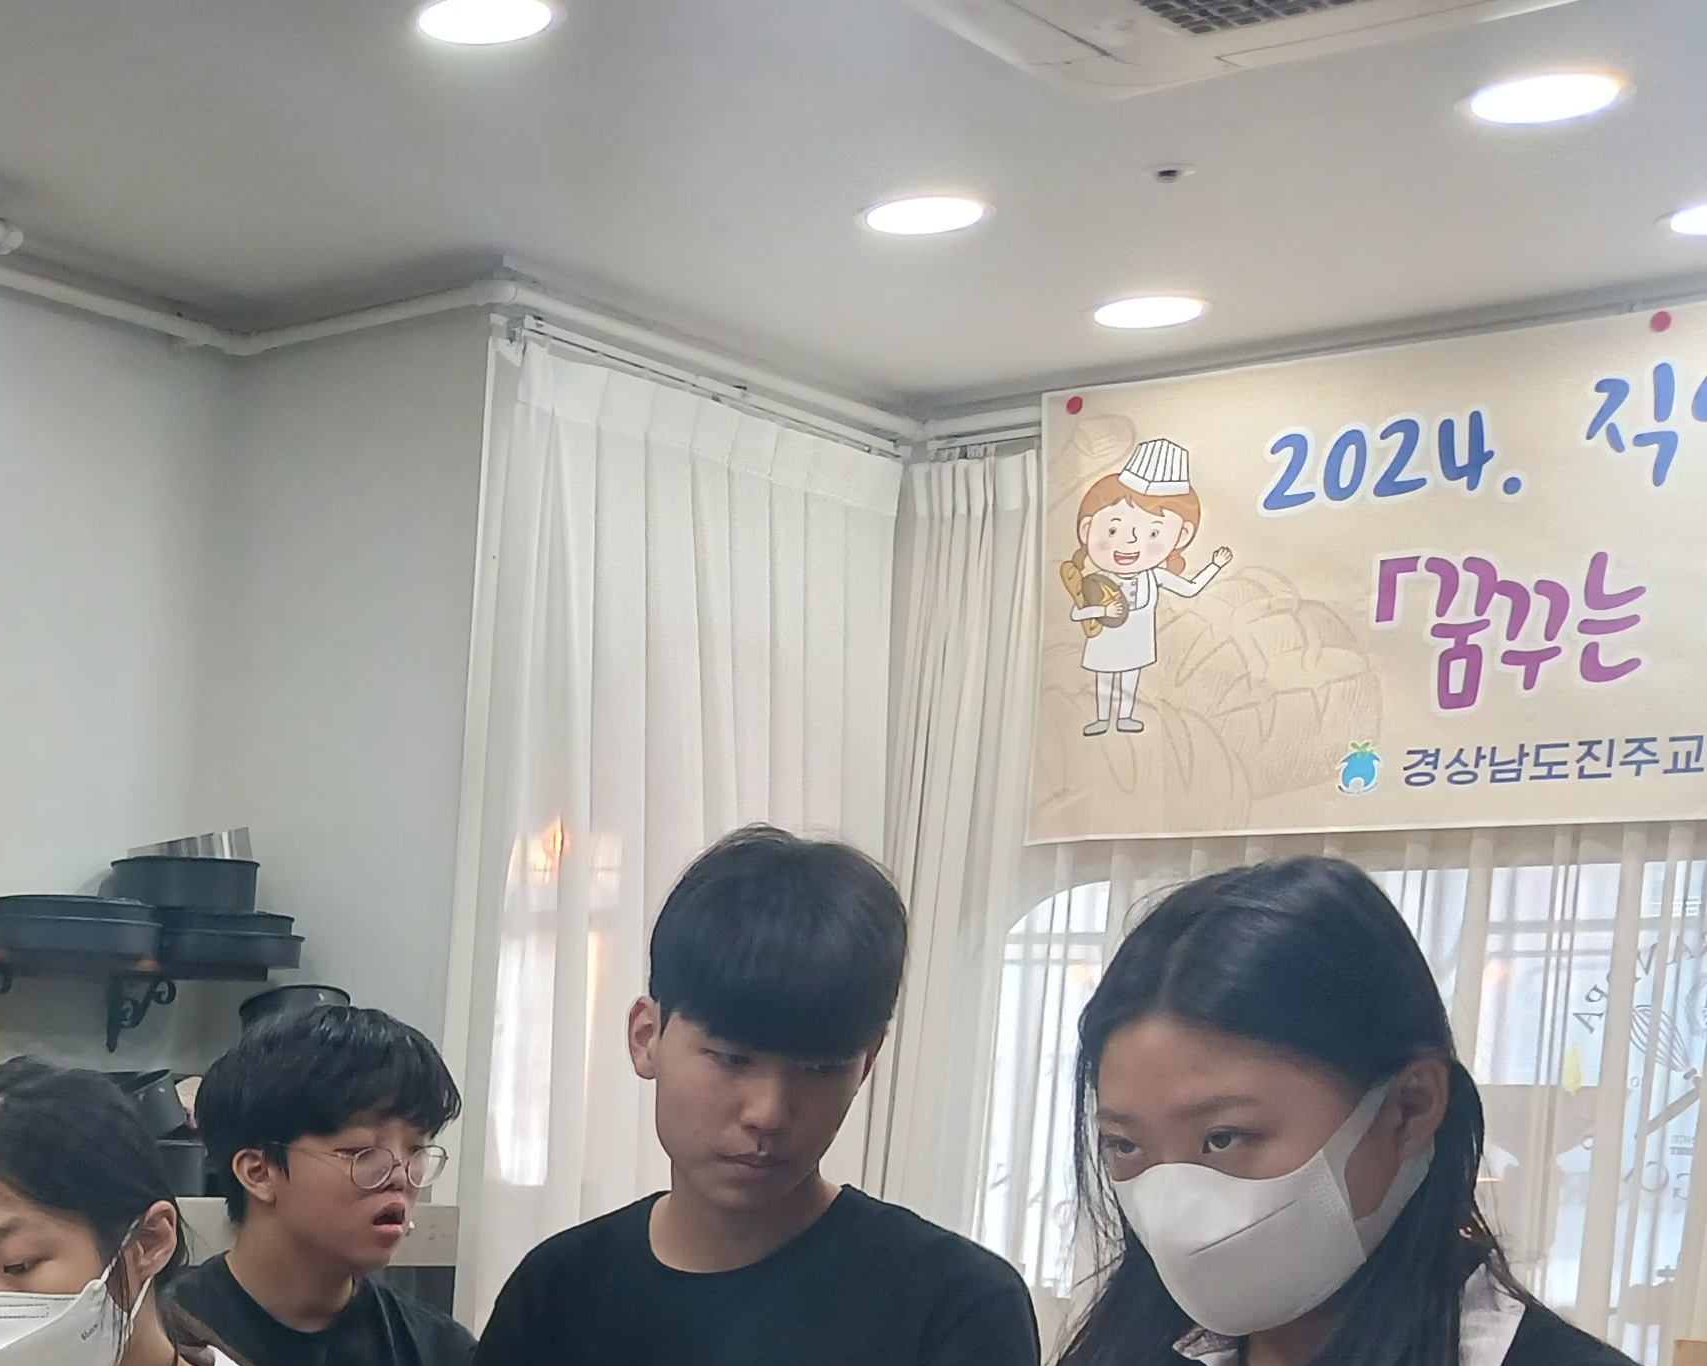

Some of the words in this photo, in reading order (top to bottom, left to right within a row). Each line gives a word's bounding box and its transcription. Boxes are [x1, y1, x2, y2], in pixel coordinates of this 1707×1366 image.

[1262, 410, 1523, 510] 2024.
[1585, 362, 1707, 487] 직
[1402, 735, 1705, 787] 경상남도진주교
